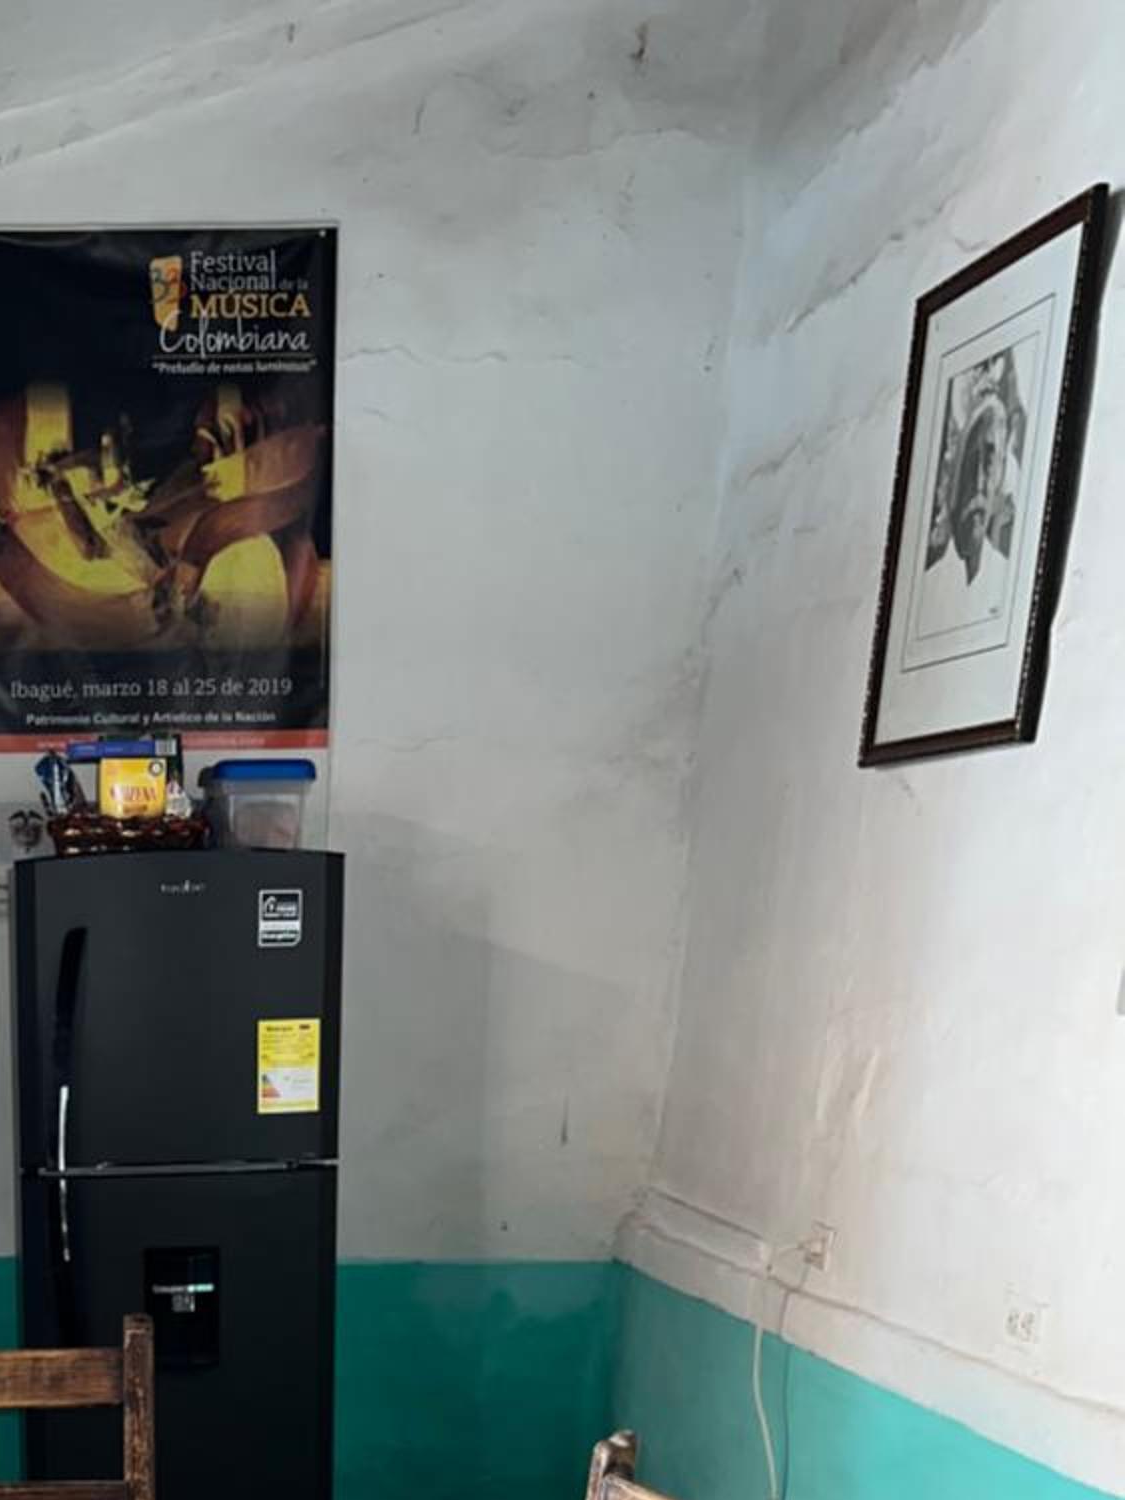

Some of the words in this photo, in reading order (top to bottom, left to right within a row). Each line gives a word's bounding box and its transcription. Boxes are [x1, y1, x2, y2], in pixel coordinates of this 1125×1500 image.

[190, 249, 275, 273] Festival
[190, 273, 275, 292] Nacional
[190, 292, 311, 318] MÚSICA
[159, 310, 310, 359] Colombiana
[10, 679, 76, 702] Ibagué,
[82, 682, 141, 697] marzo
[147, 678, 169, 697] 18
[172, 678, 190, 696] al
[194, 678, 216, 696] 25
[220, 677, 244, 696] de
[248, 677, 293, 696] 2019
